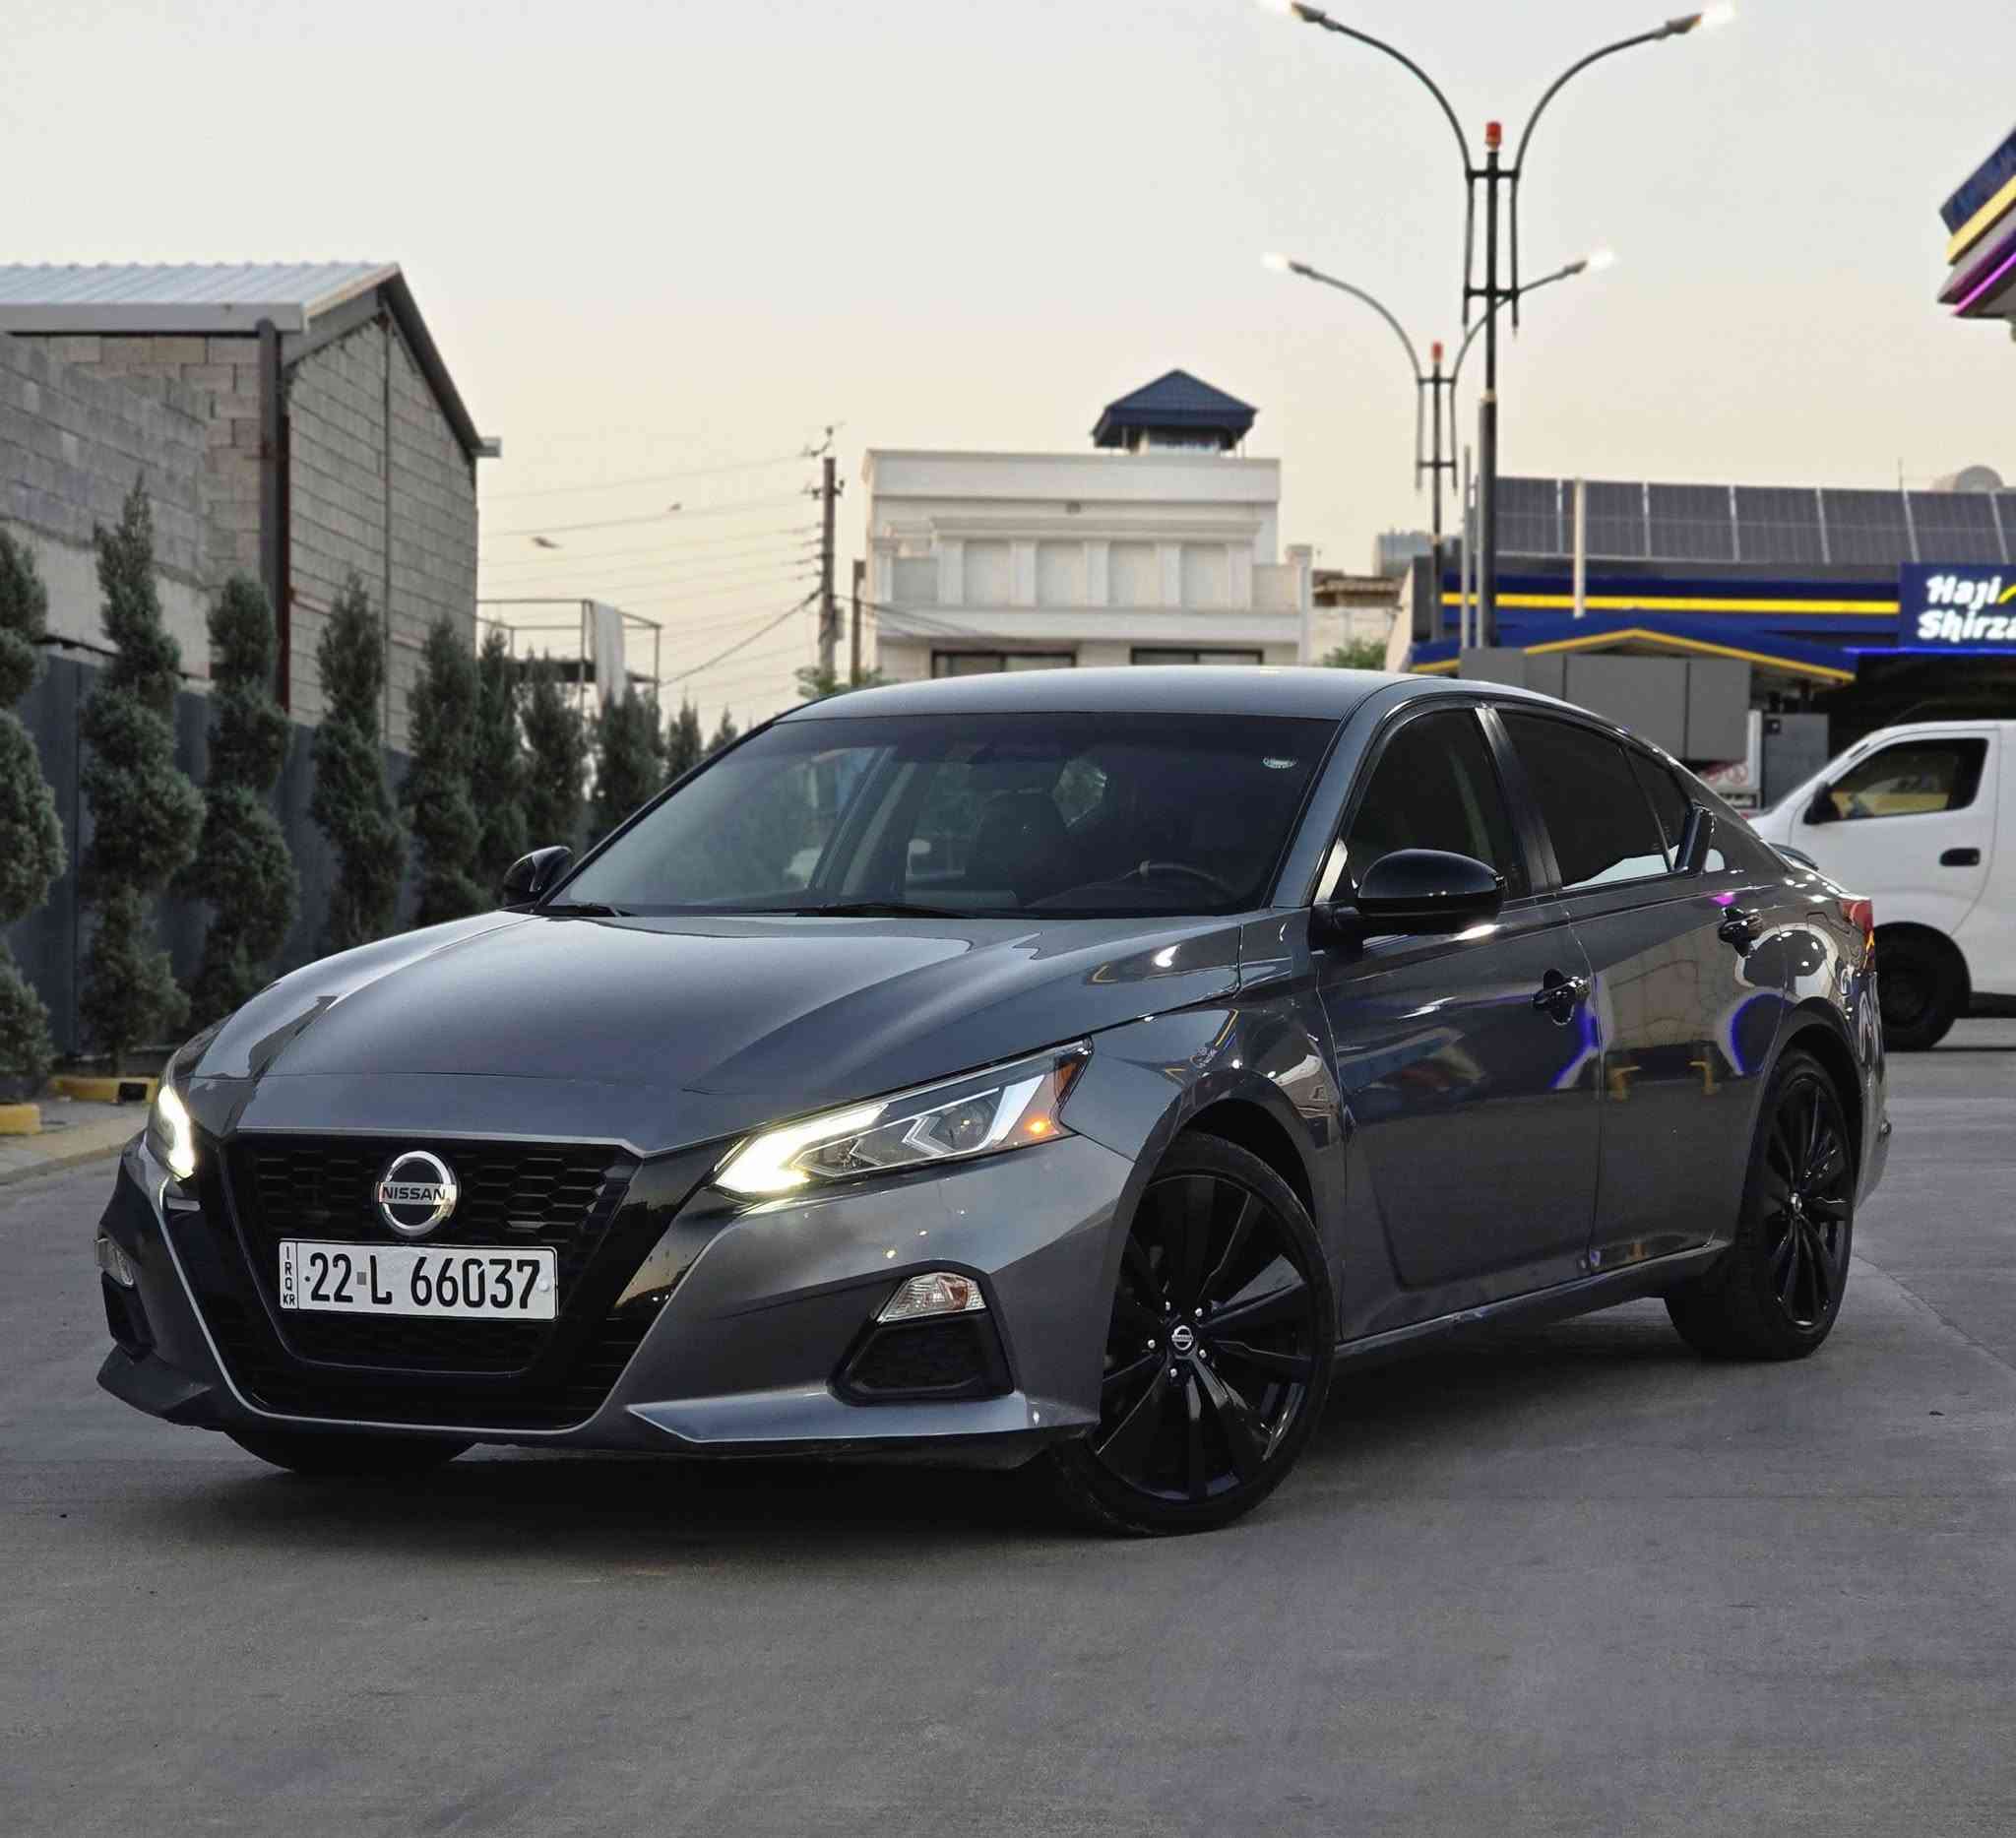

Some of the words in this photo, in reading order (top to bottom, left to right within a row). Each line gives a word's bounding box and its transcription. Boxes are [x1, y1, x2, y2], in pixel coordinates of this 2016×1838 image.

[382, 1185, 446, 1201] NISSAN
[309, 1251, 353, 1303] 22
[370, 1254, 393, 1305] L
[410, 1256, 540, 1309] 66037
